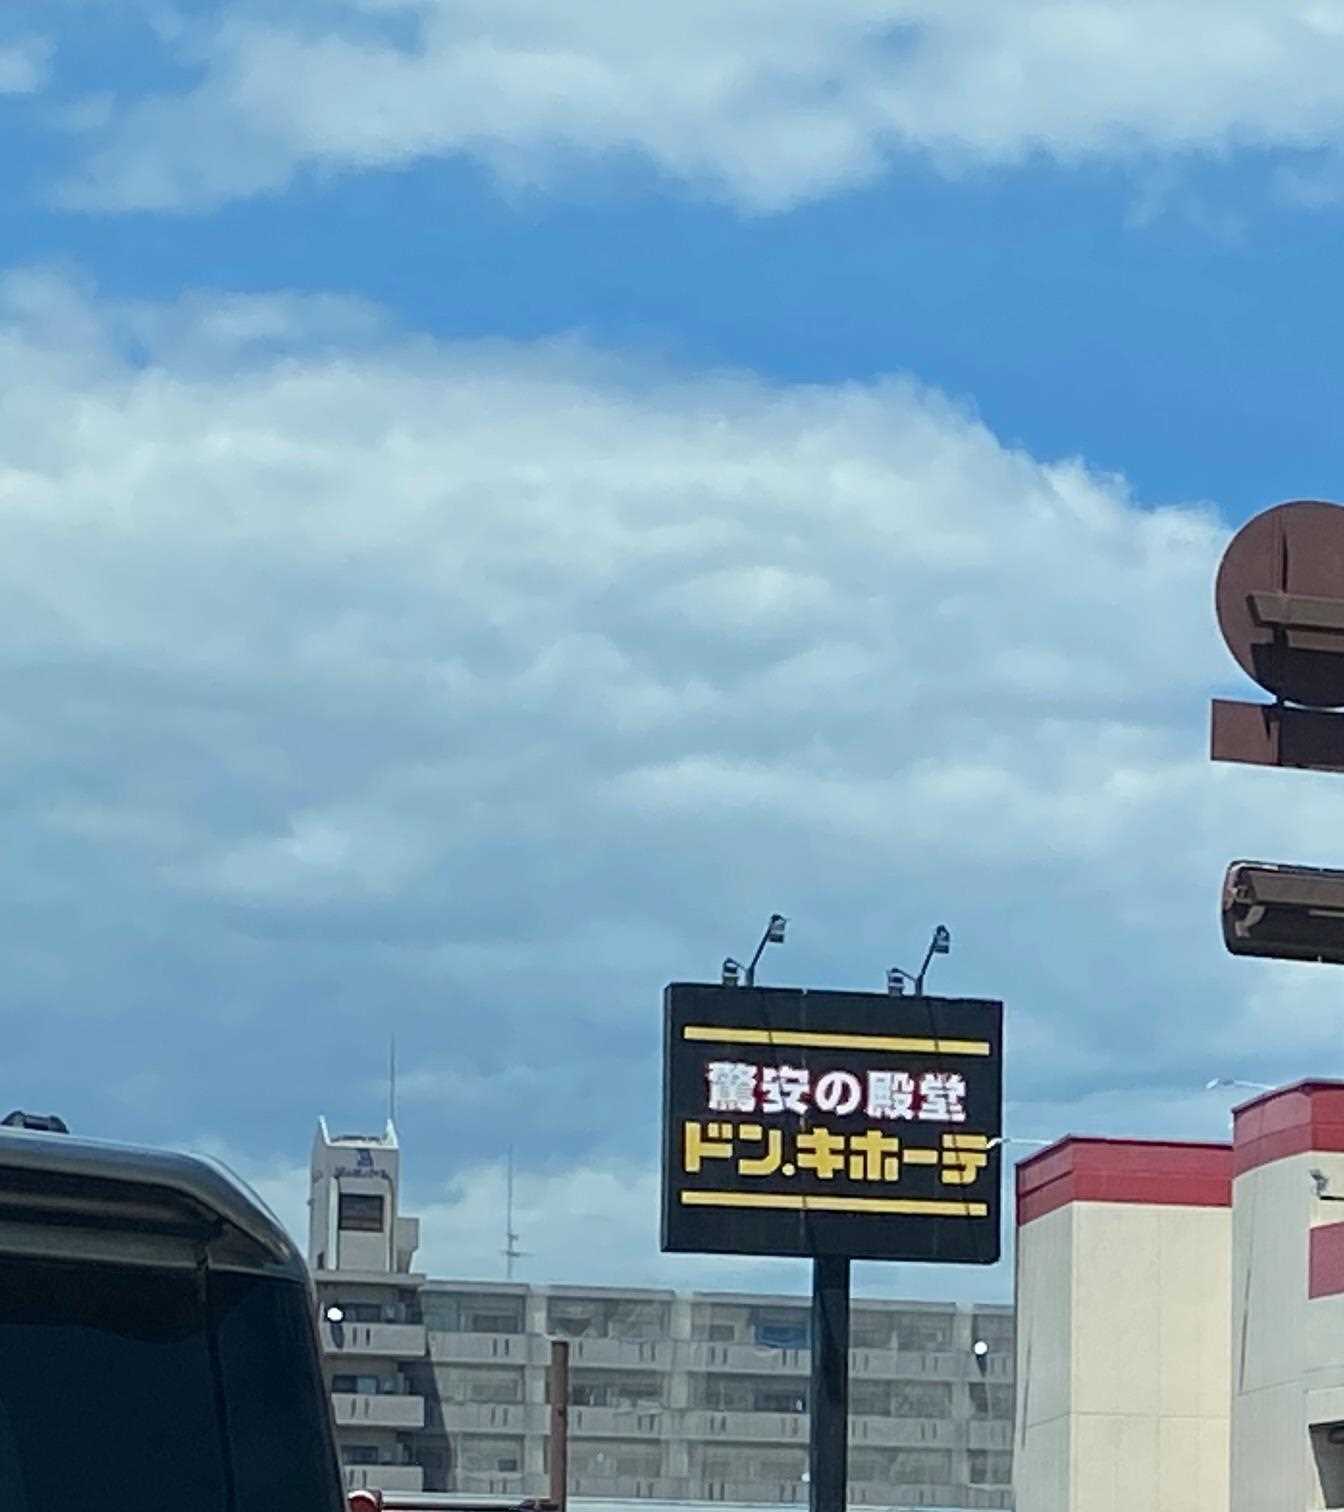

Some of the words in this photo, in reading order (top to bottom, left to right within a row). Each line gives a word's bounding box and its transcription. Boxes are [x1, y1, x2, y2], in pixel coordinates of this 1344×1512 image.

[708, 1061, 967, 1123] 驚安の殿堂
